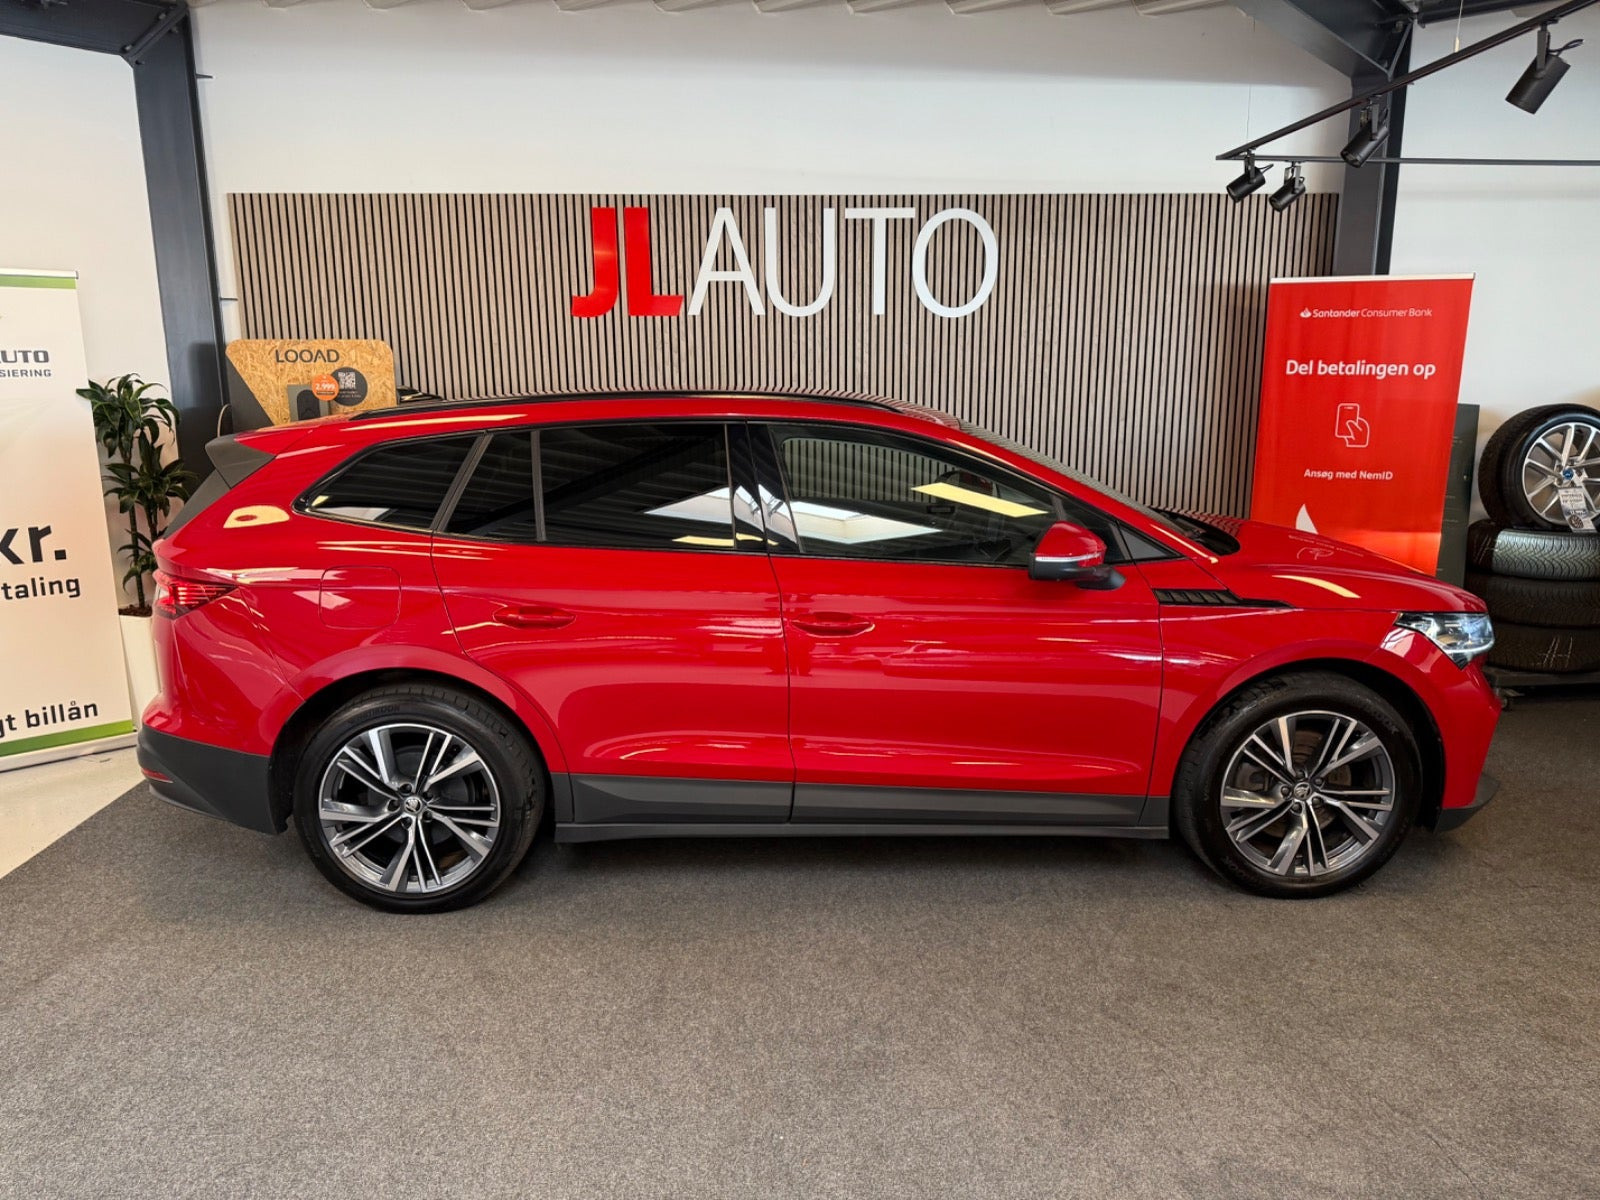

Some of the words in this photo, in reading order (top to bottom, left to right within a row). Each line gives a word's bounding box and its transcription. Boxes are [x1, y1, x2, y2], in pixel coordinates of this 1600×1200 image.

[571, 206, 684, 318] JL
[688, 206, 998, 318] AUTO
[1312, 308, 1360, 318] Santander
[1360, 307, 1408, 318] Consumer
[1408, 307, 1433, 317] Bank
[0, 350, 49, 363] UTO
[275, 348, 340, 363] LOOAD
[1285, 359, 1314, 375] Del
[1317, 359, 1409, 380] betalingen
[1412, 363, 1436, 380] op
[1304, 468, 1333, 480] Ansøg
[1335, 470, 1357, 480] med
[1359, 470, 1393, 481] NemID
[1, 577, 81, 600] taling
[25, 700, 98, 728] billån
